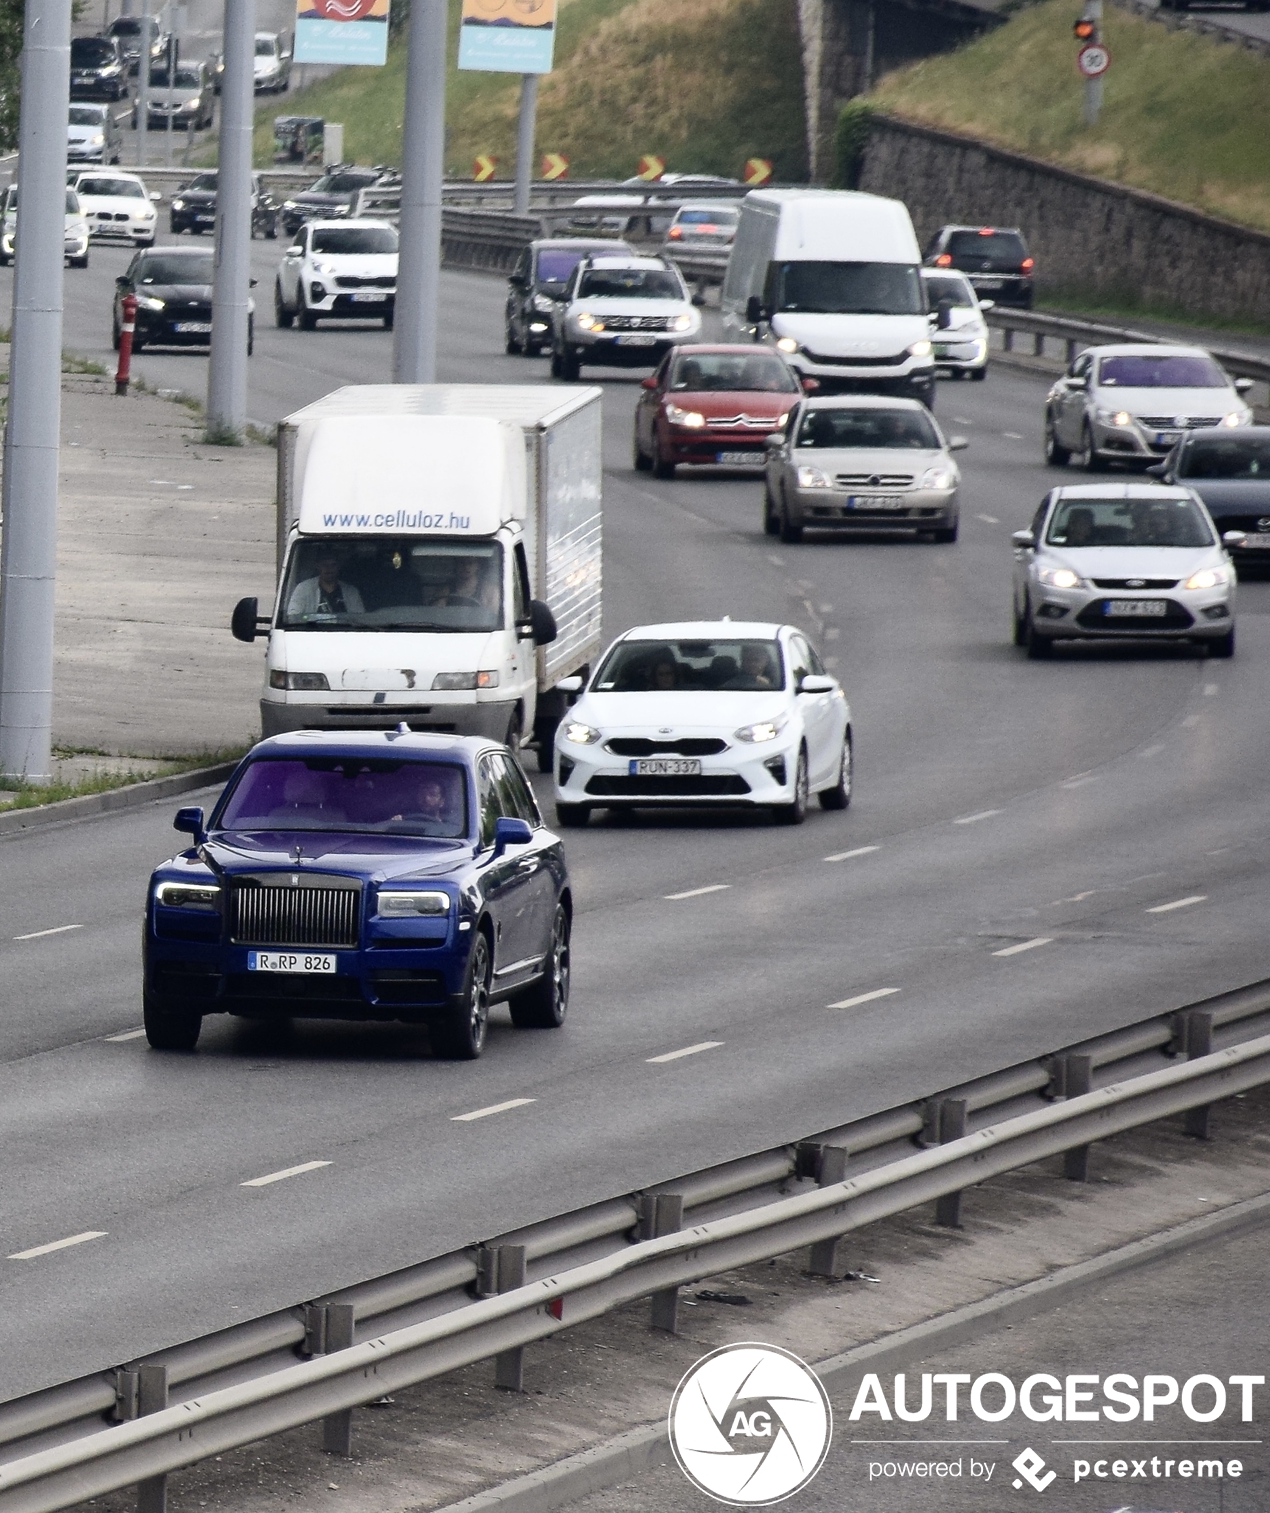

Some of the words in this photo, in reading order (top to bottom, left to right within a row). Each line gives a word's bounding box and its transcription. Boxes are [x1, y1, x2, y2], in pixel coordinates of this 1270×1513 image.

[323, 510, 470, 529] www.celluloz.hu
[639, 761, 697, 773] RUN-337
[304, 956, 331, 970] 826
